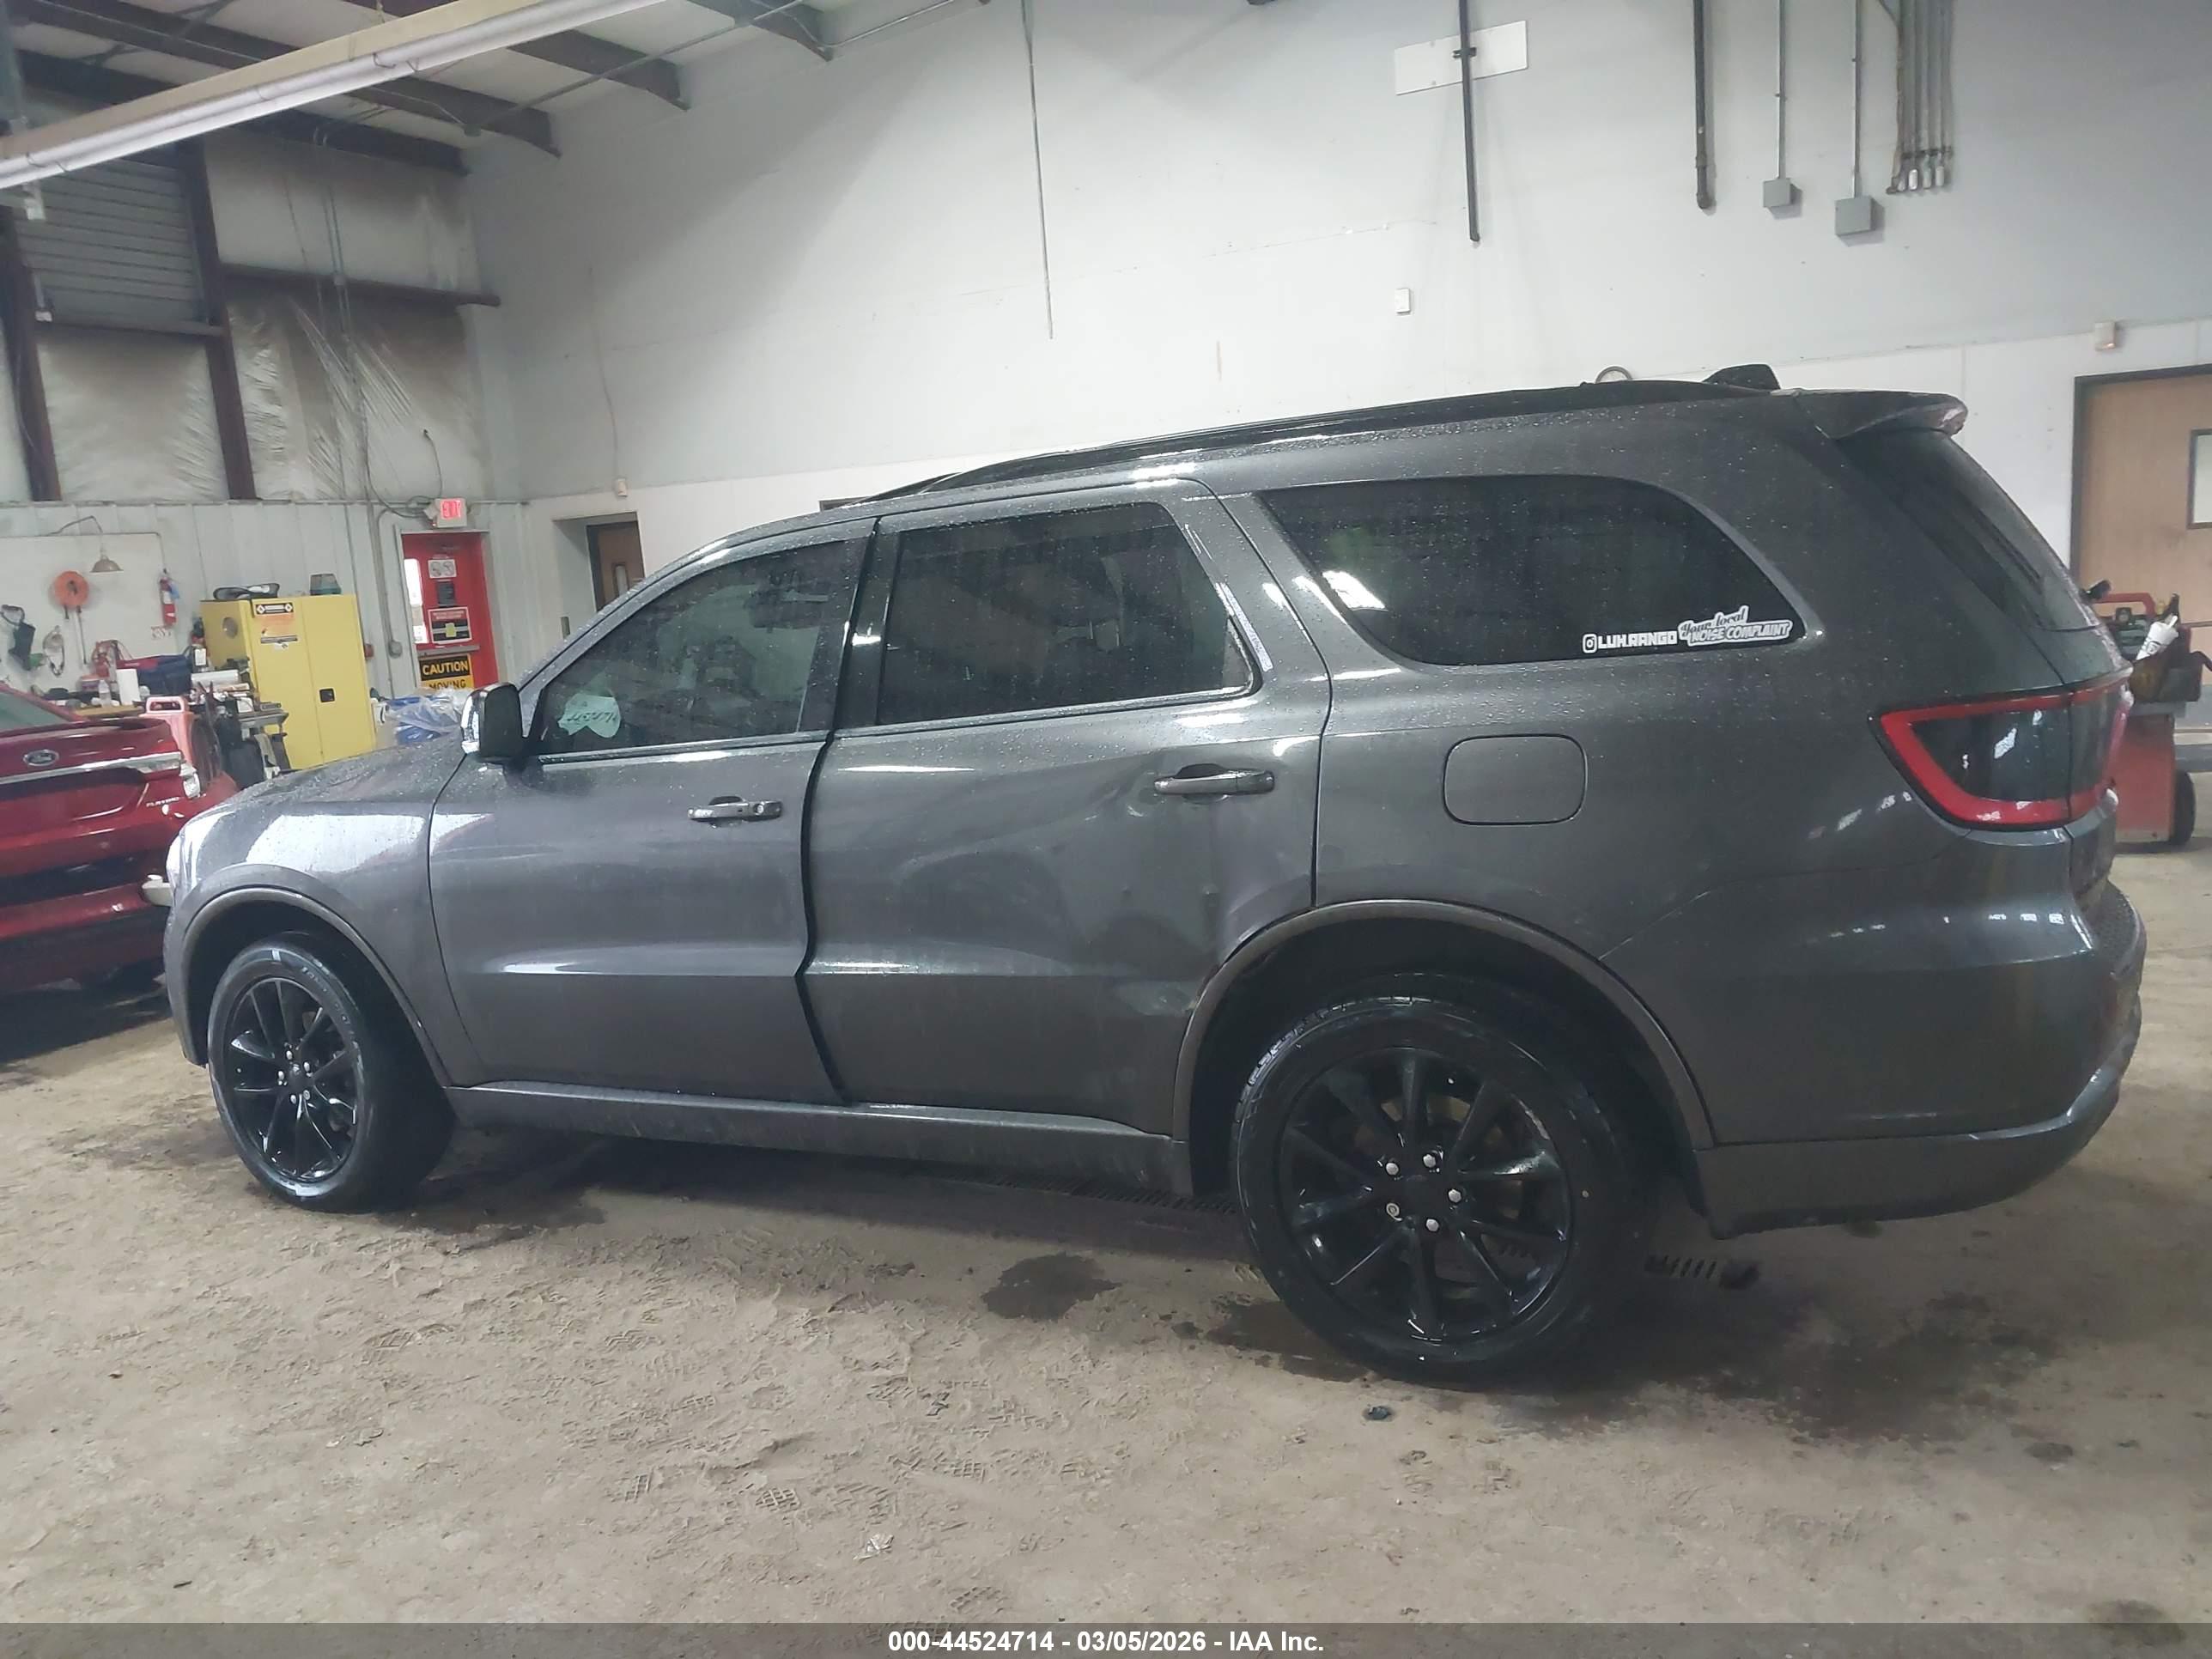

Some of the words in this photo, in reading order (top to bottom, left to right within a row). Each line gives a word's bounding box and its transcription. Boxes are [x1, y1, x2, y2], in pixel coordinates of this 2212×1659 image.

[1690, 627, 1725, 643] NOISE
[1727, 623, 1790, 638] COMPLAINT
[422, 660, 469, 676] CAUTION
